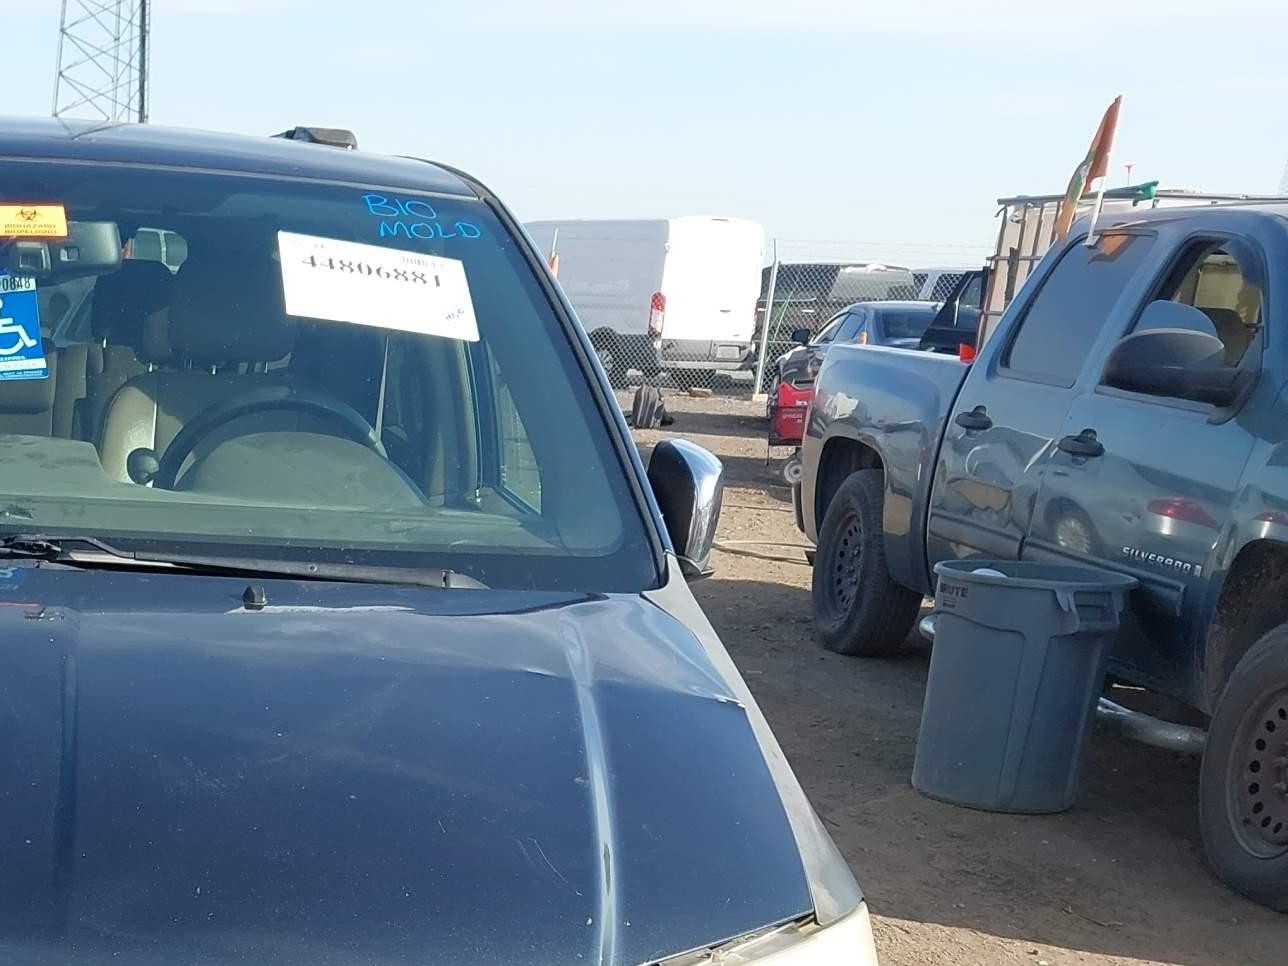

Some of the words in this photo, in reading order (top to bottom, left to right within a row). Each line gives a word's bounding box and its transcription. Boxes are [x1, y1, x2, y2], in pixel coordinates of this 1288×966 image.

[362, 194, 437, 219] BIO
[379, 221, 481, 239] MOLD
[302, 255, 441, 287] 44806881
[1122, 546, 1192, 573] SILVERADO
